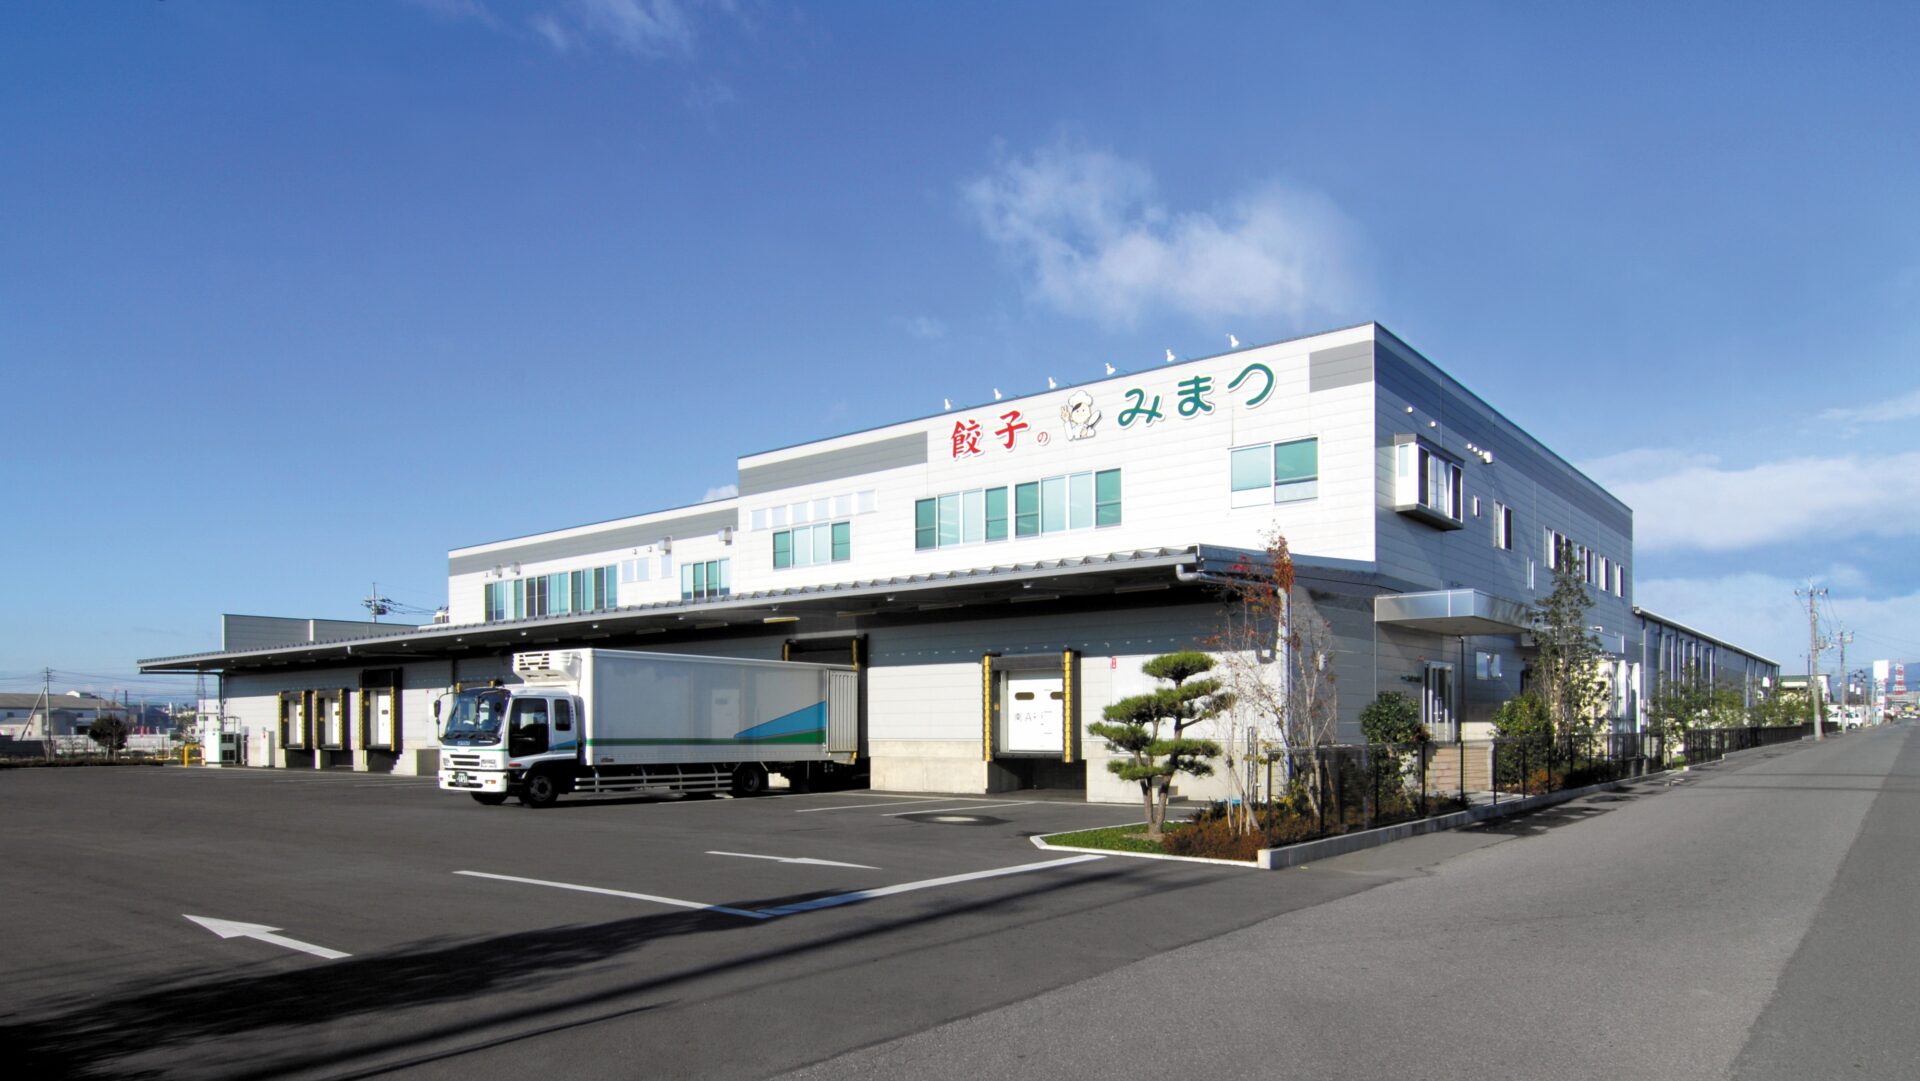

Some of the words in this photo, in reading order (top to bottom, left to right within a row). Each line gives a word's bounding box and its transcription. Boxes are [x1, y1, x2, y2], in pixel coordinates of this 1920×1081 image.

[951, 410, 1048, 458] 餃子の
[1117, 363, 1276, 428] みまつ
